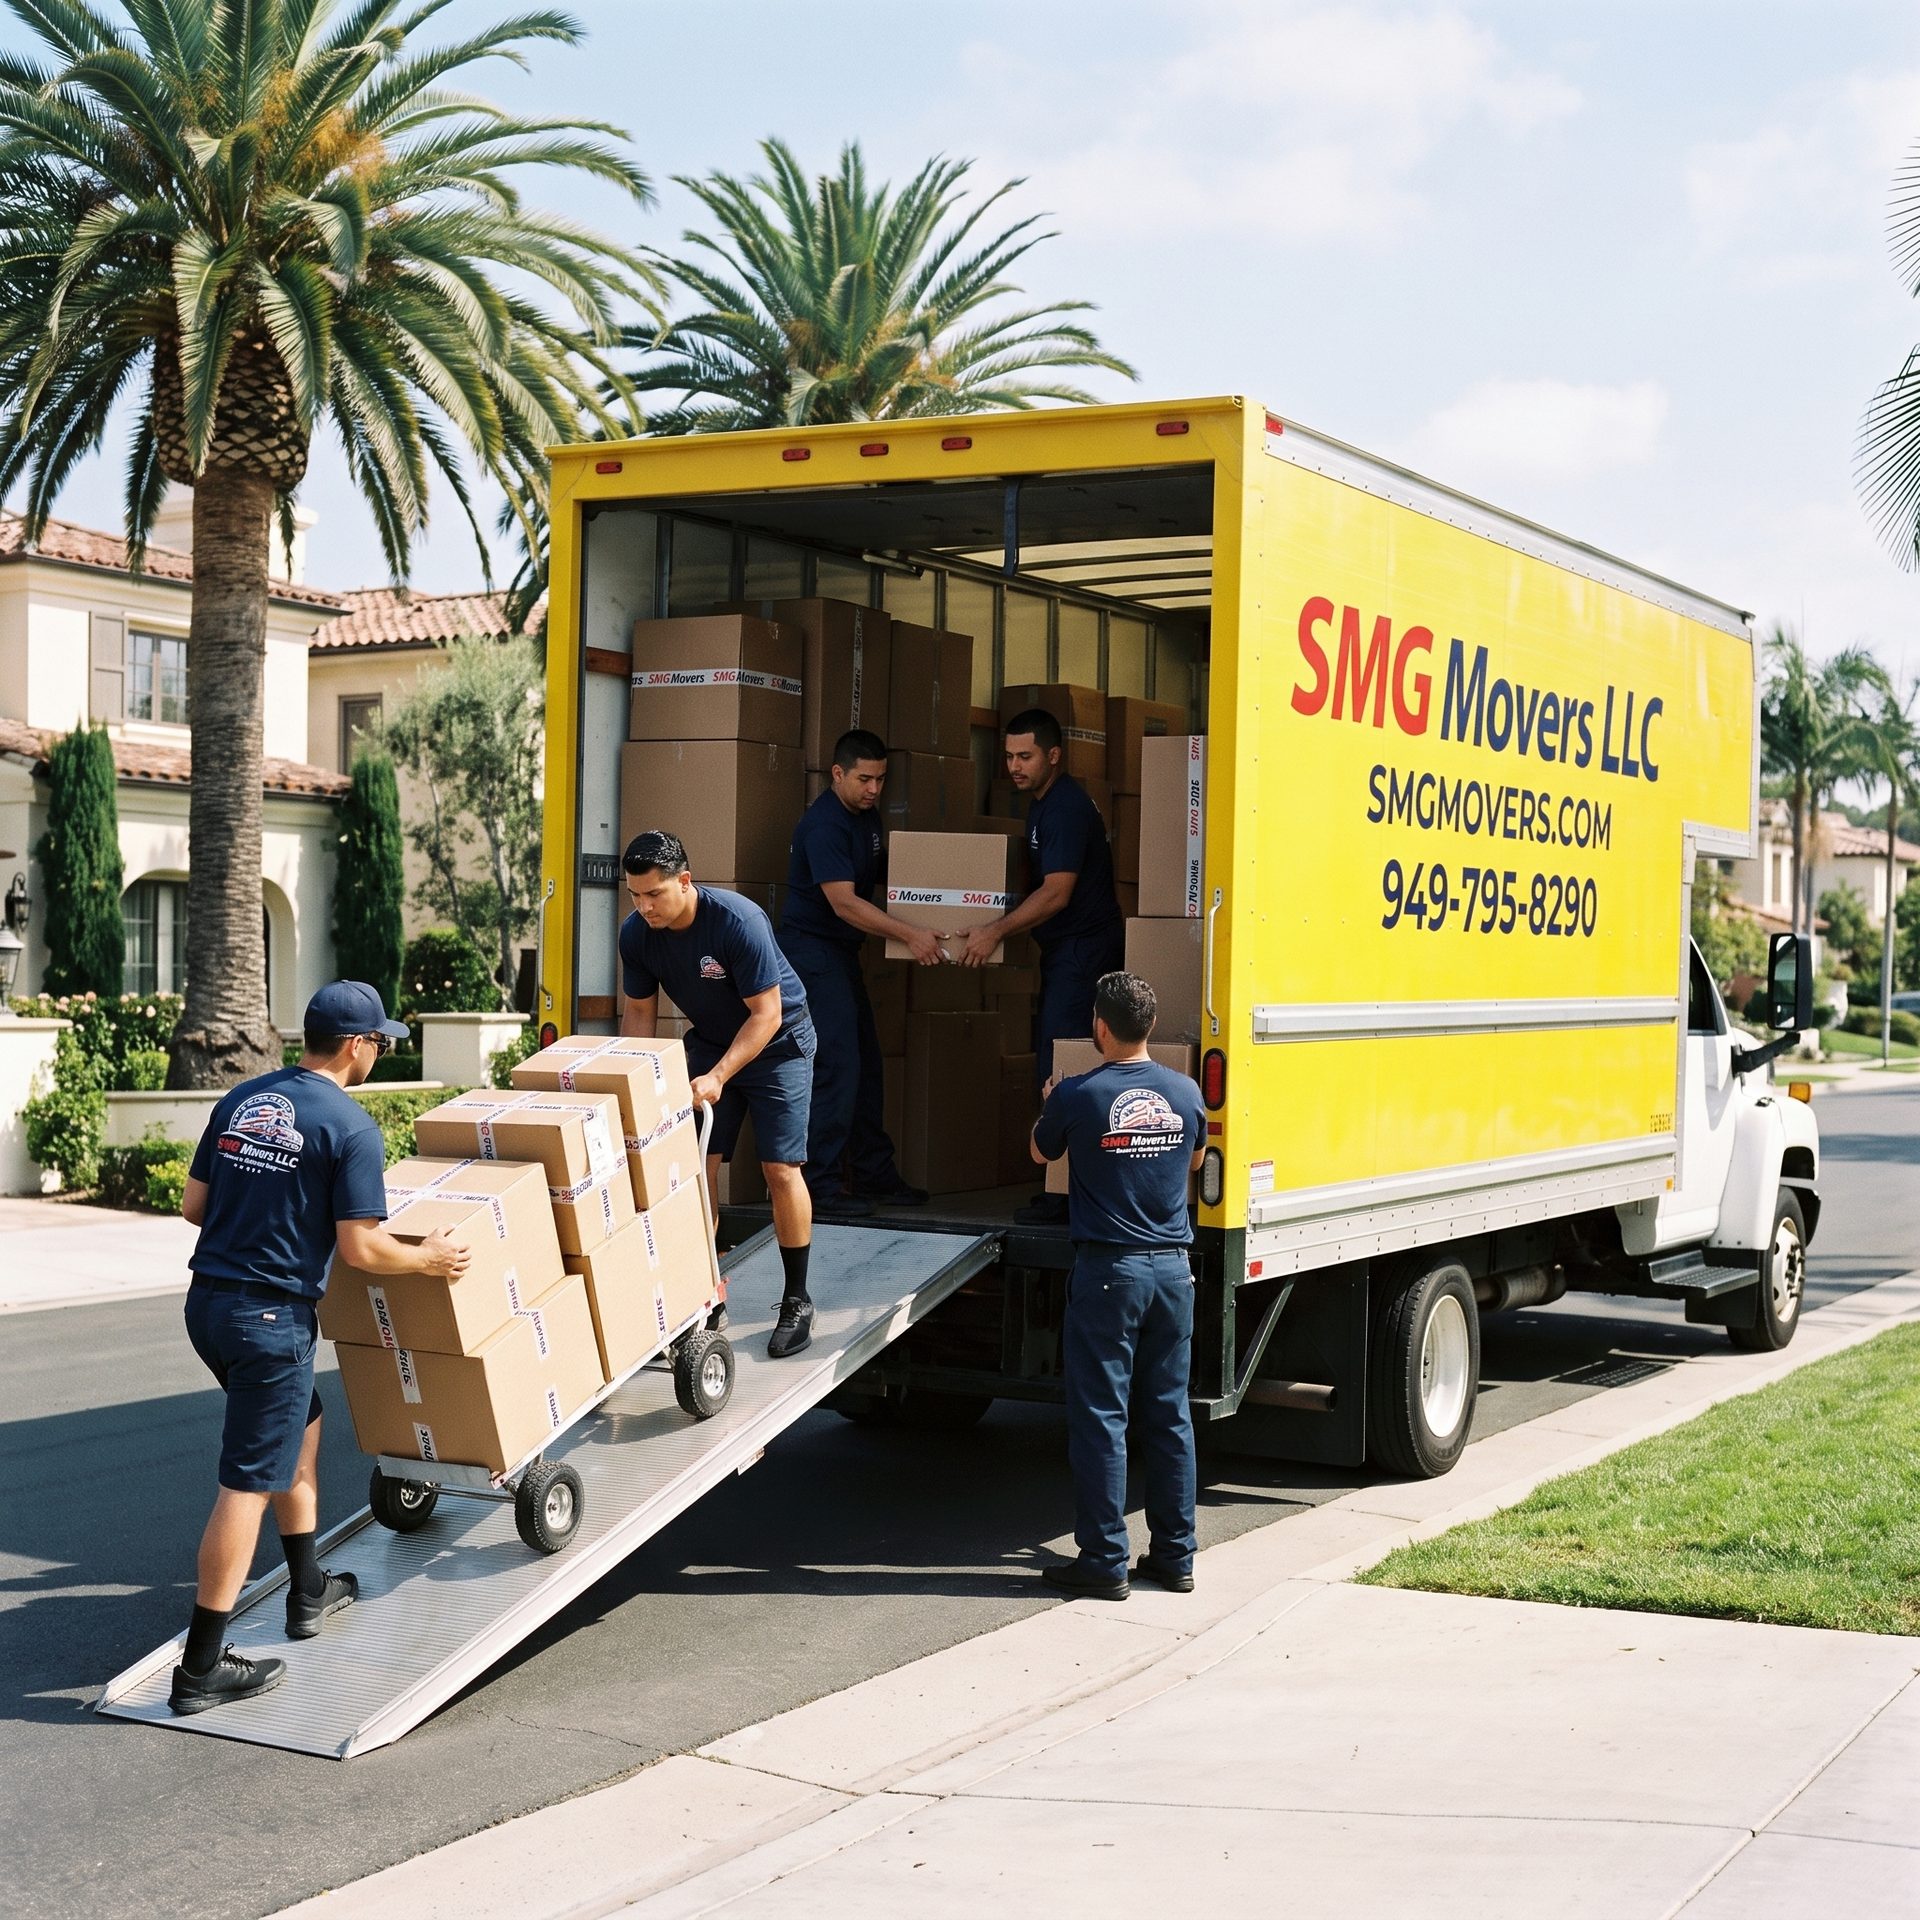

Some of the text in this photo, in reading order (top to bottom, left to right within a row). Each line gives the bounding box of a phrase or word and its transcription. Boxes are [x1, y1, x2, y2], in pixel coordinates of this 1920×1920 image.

[648, 673, 671, 684] SMG
[671, 672, 705, 684] Movers
[713, 671, 736, 682] SMG
[1290, 596, 1664, 783] SMG Movers LLC
[1366, 764, 1613, 851] SMGMOVERS.COM
[898, 890, 943, 903] Movers
[962, 893, 992, 905] SMG
[1381, 858, 1598, 938] 949-795-8290
[275, 1152, 299, 1168] LLC
